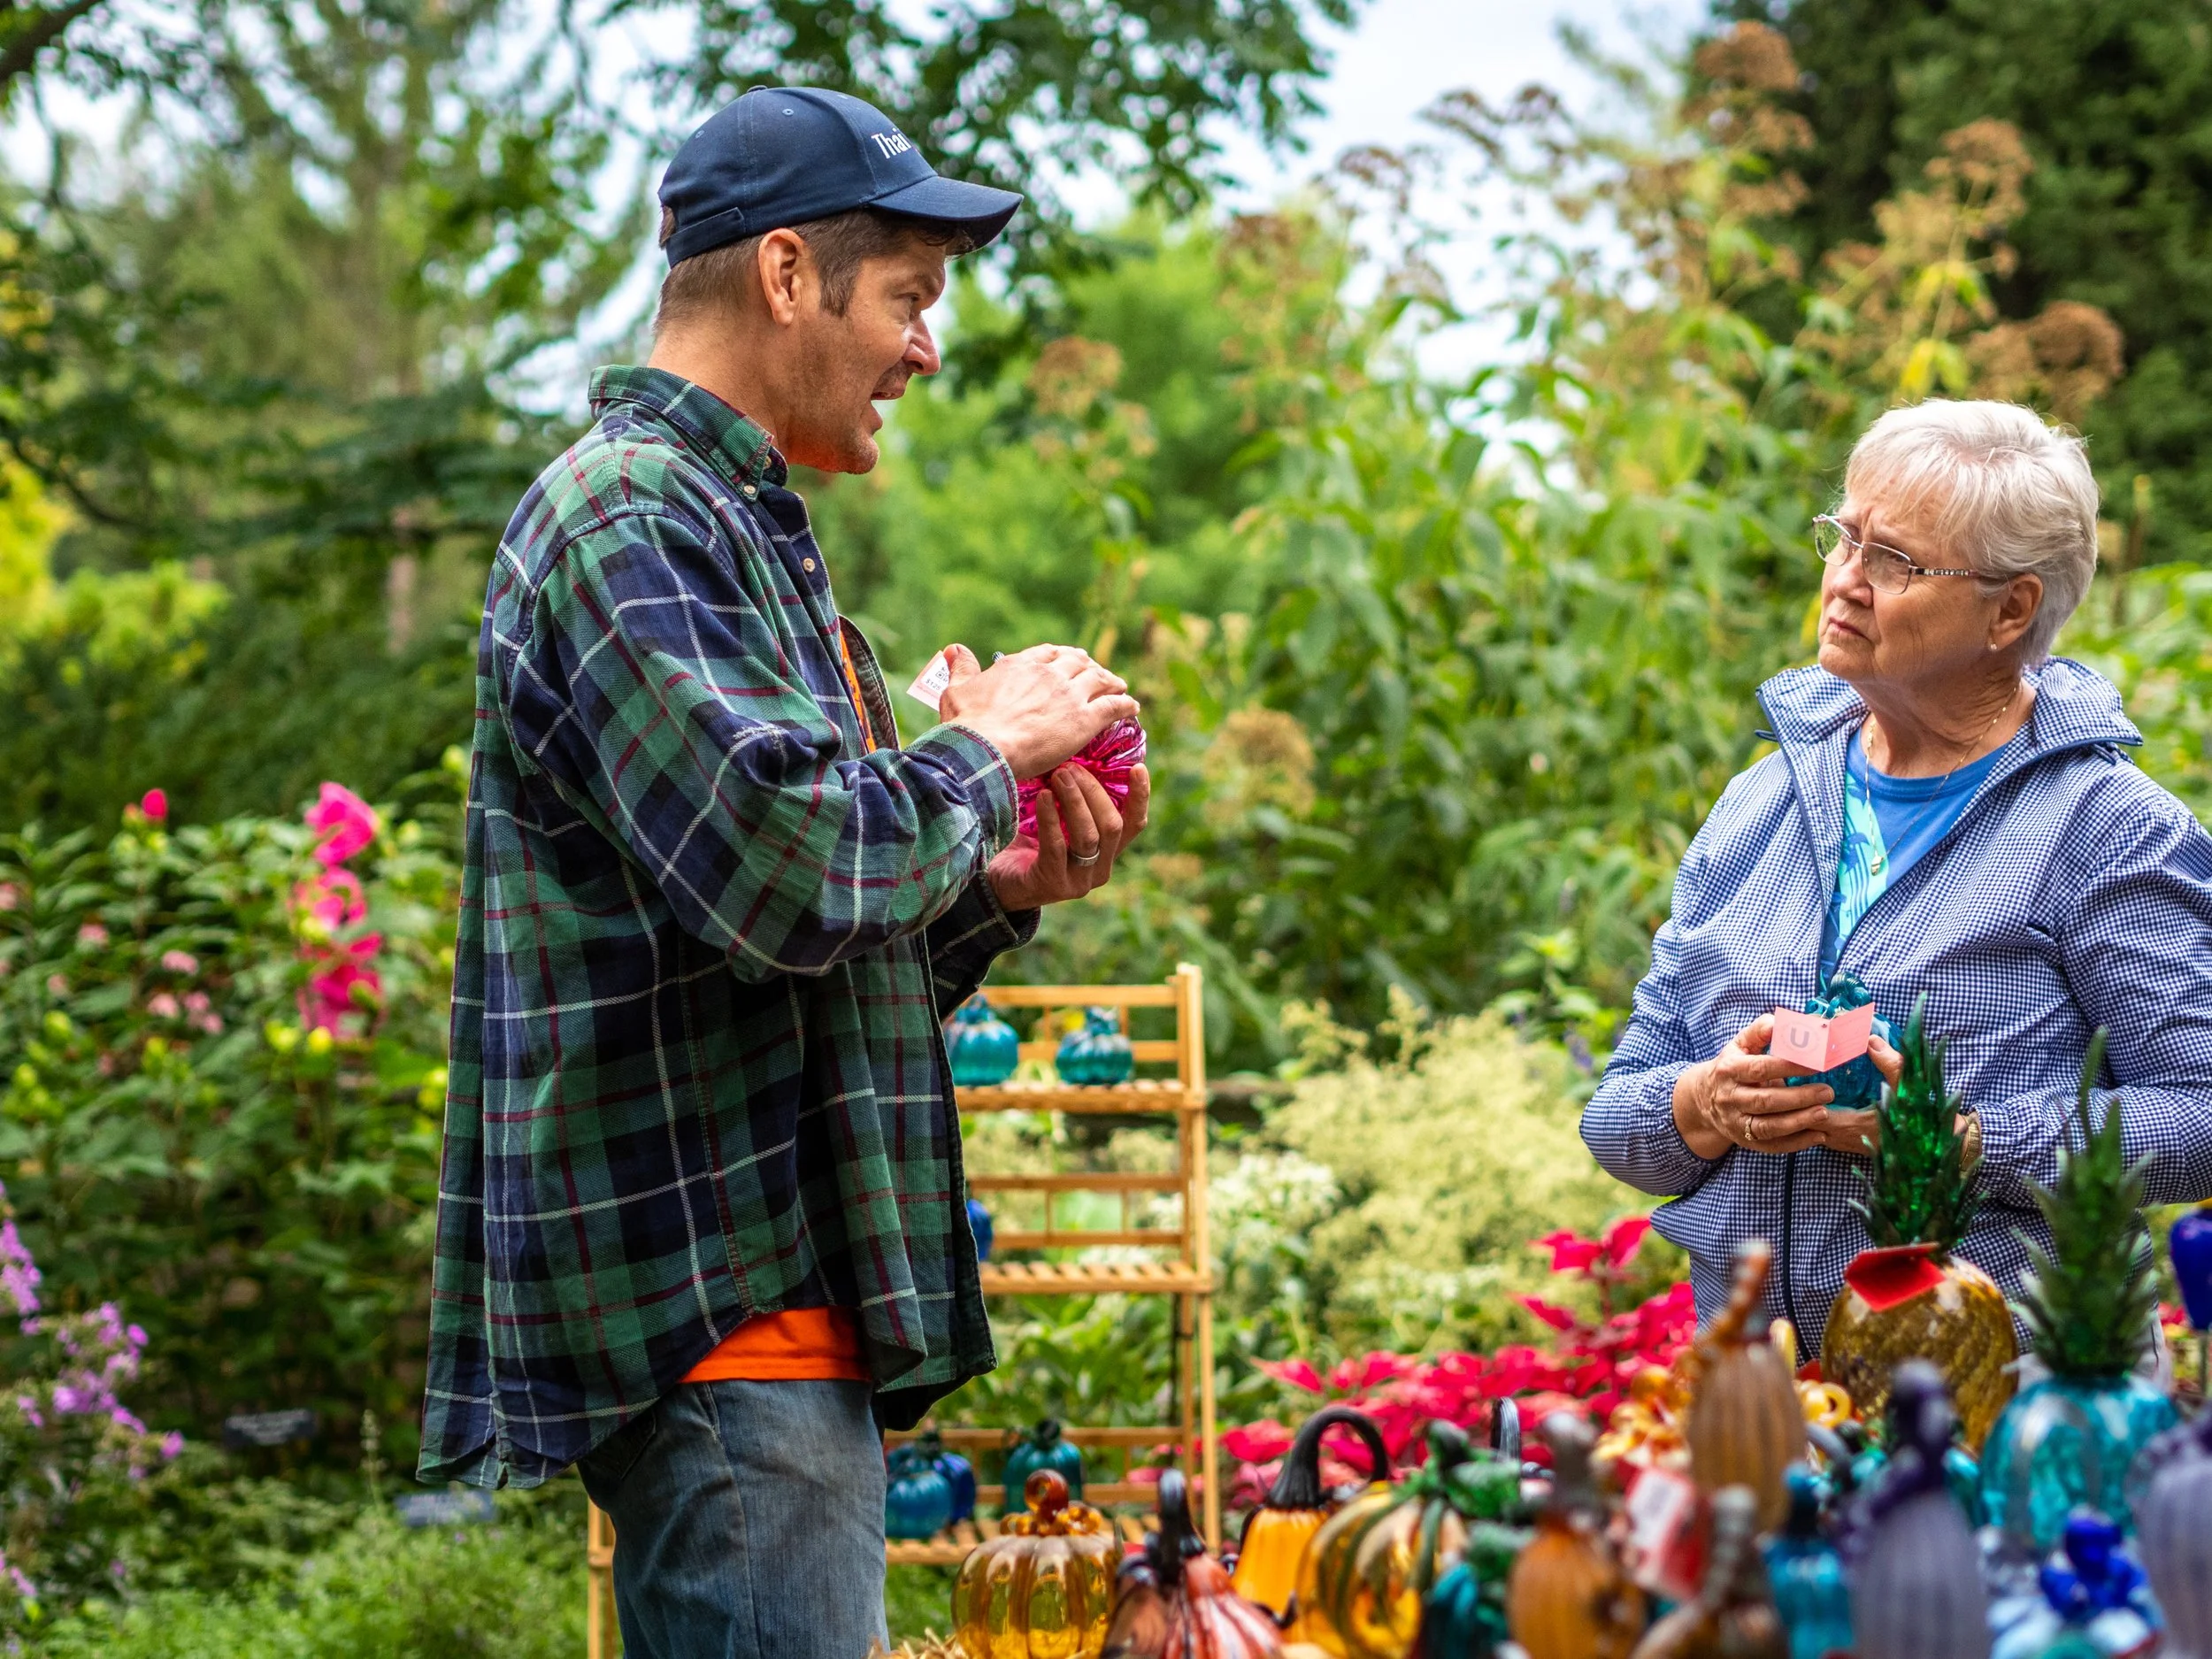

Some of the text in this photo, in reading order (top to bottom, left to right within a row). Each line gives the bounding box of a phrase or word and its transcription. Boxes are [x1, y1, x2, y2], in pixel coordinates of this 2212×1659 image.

[871, 128, 912, 159] Thai
[926, 679, 941, 690] $125
[1790, 1027, 1809, 1048] U
